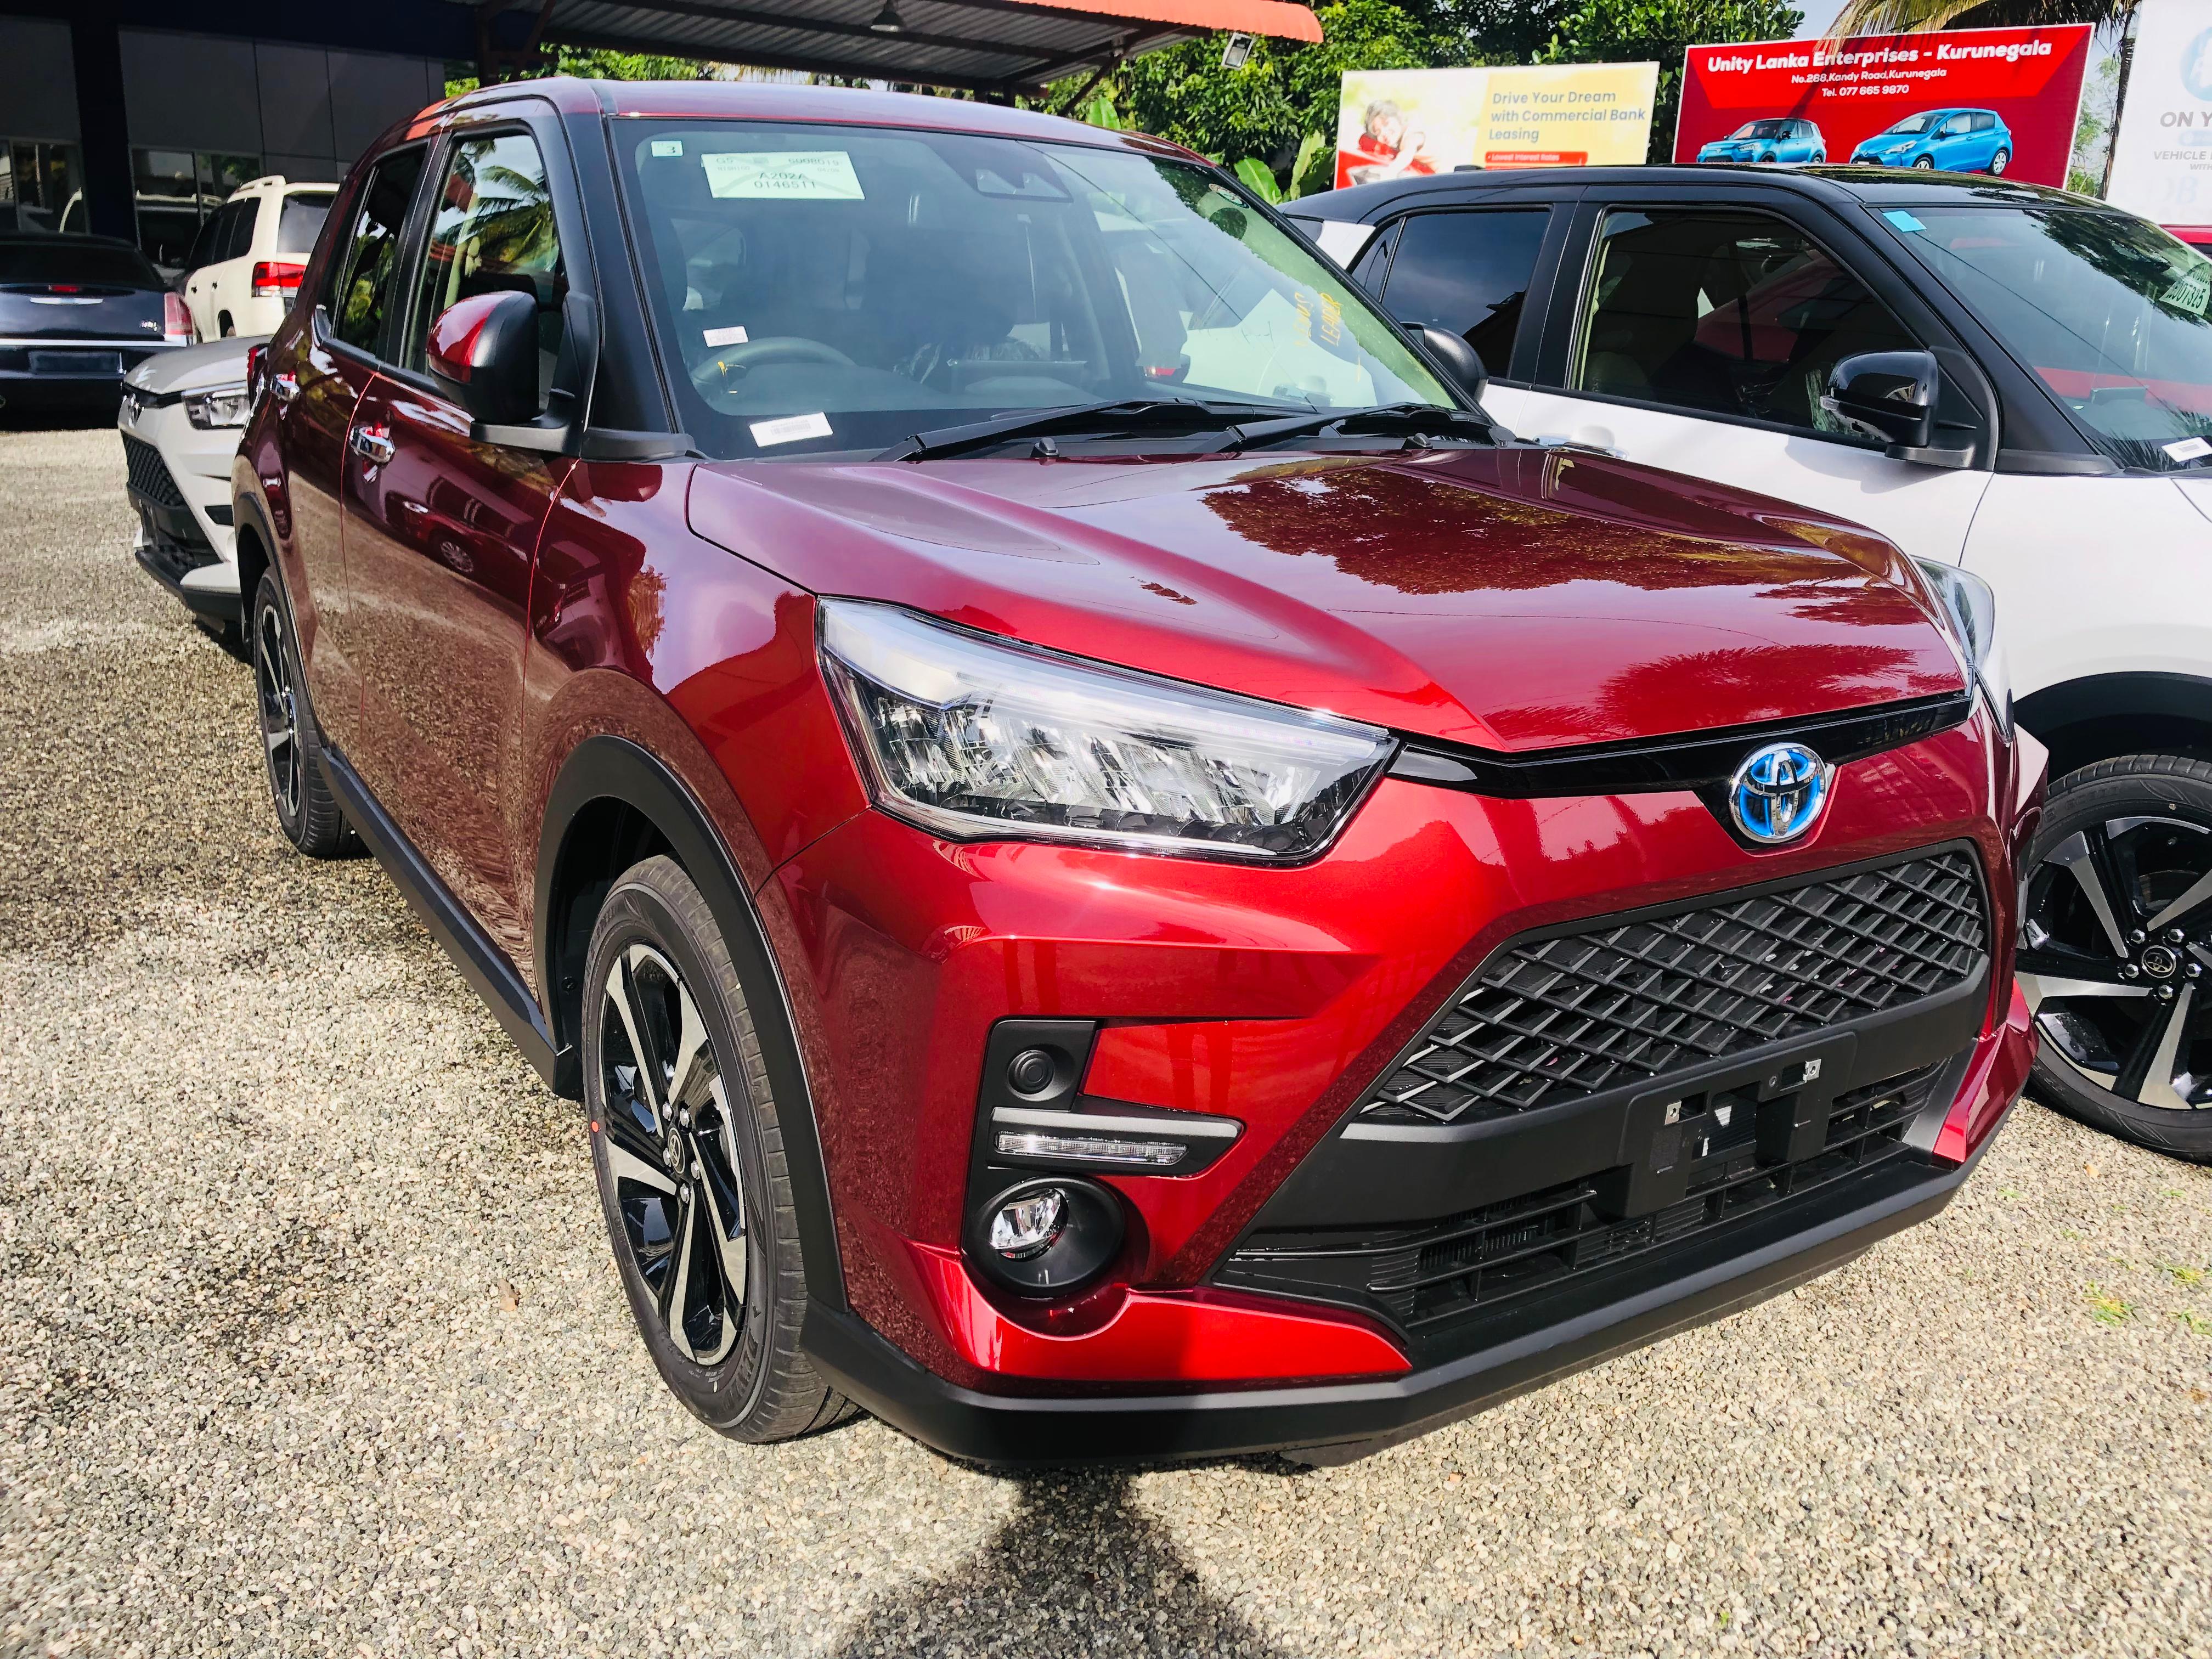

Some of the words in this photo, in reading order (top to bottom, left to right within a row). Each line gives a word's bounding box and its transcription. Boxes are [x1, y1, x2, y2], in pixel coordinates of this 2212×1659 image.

[1708, 56, 1754, 74] Unity
[1756, 53, 1809, 70] Lanka
[1813, 47, 1918, 67] Enterprises
[1937, 40, 2052, 62] Kurunegala
[1861, 68, 1947, 80] Road,Kurunegala
[1822, 87, 1837, 97] Tel.
[1839, 86, 1858, 96] 077
[1859, 85, 1880, 95] 665
[1882, 84, 1910, 94] 9870
[1493, 92, 1528, 104] Drive
[1532, 92, 1564, 103] Your
[1568, 91, 1616, 103] Dream
[1491, 110, 1519, 122] with
[1520, 109, 1606, 121] Commercial
[1610, 108, 1645, 120] Bank
[2160, 111, 2194, 128] ON
[1489, 128, 1539, 143] Leasing
[2153, 151, 2207, 160] VEHICLE
[759, 172, 808, 180] A202A
[754, 180, 816, 189] 0146511
